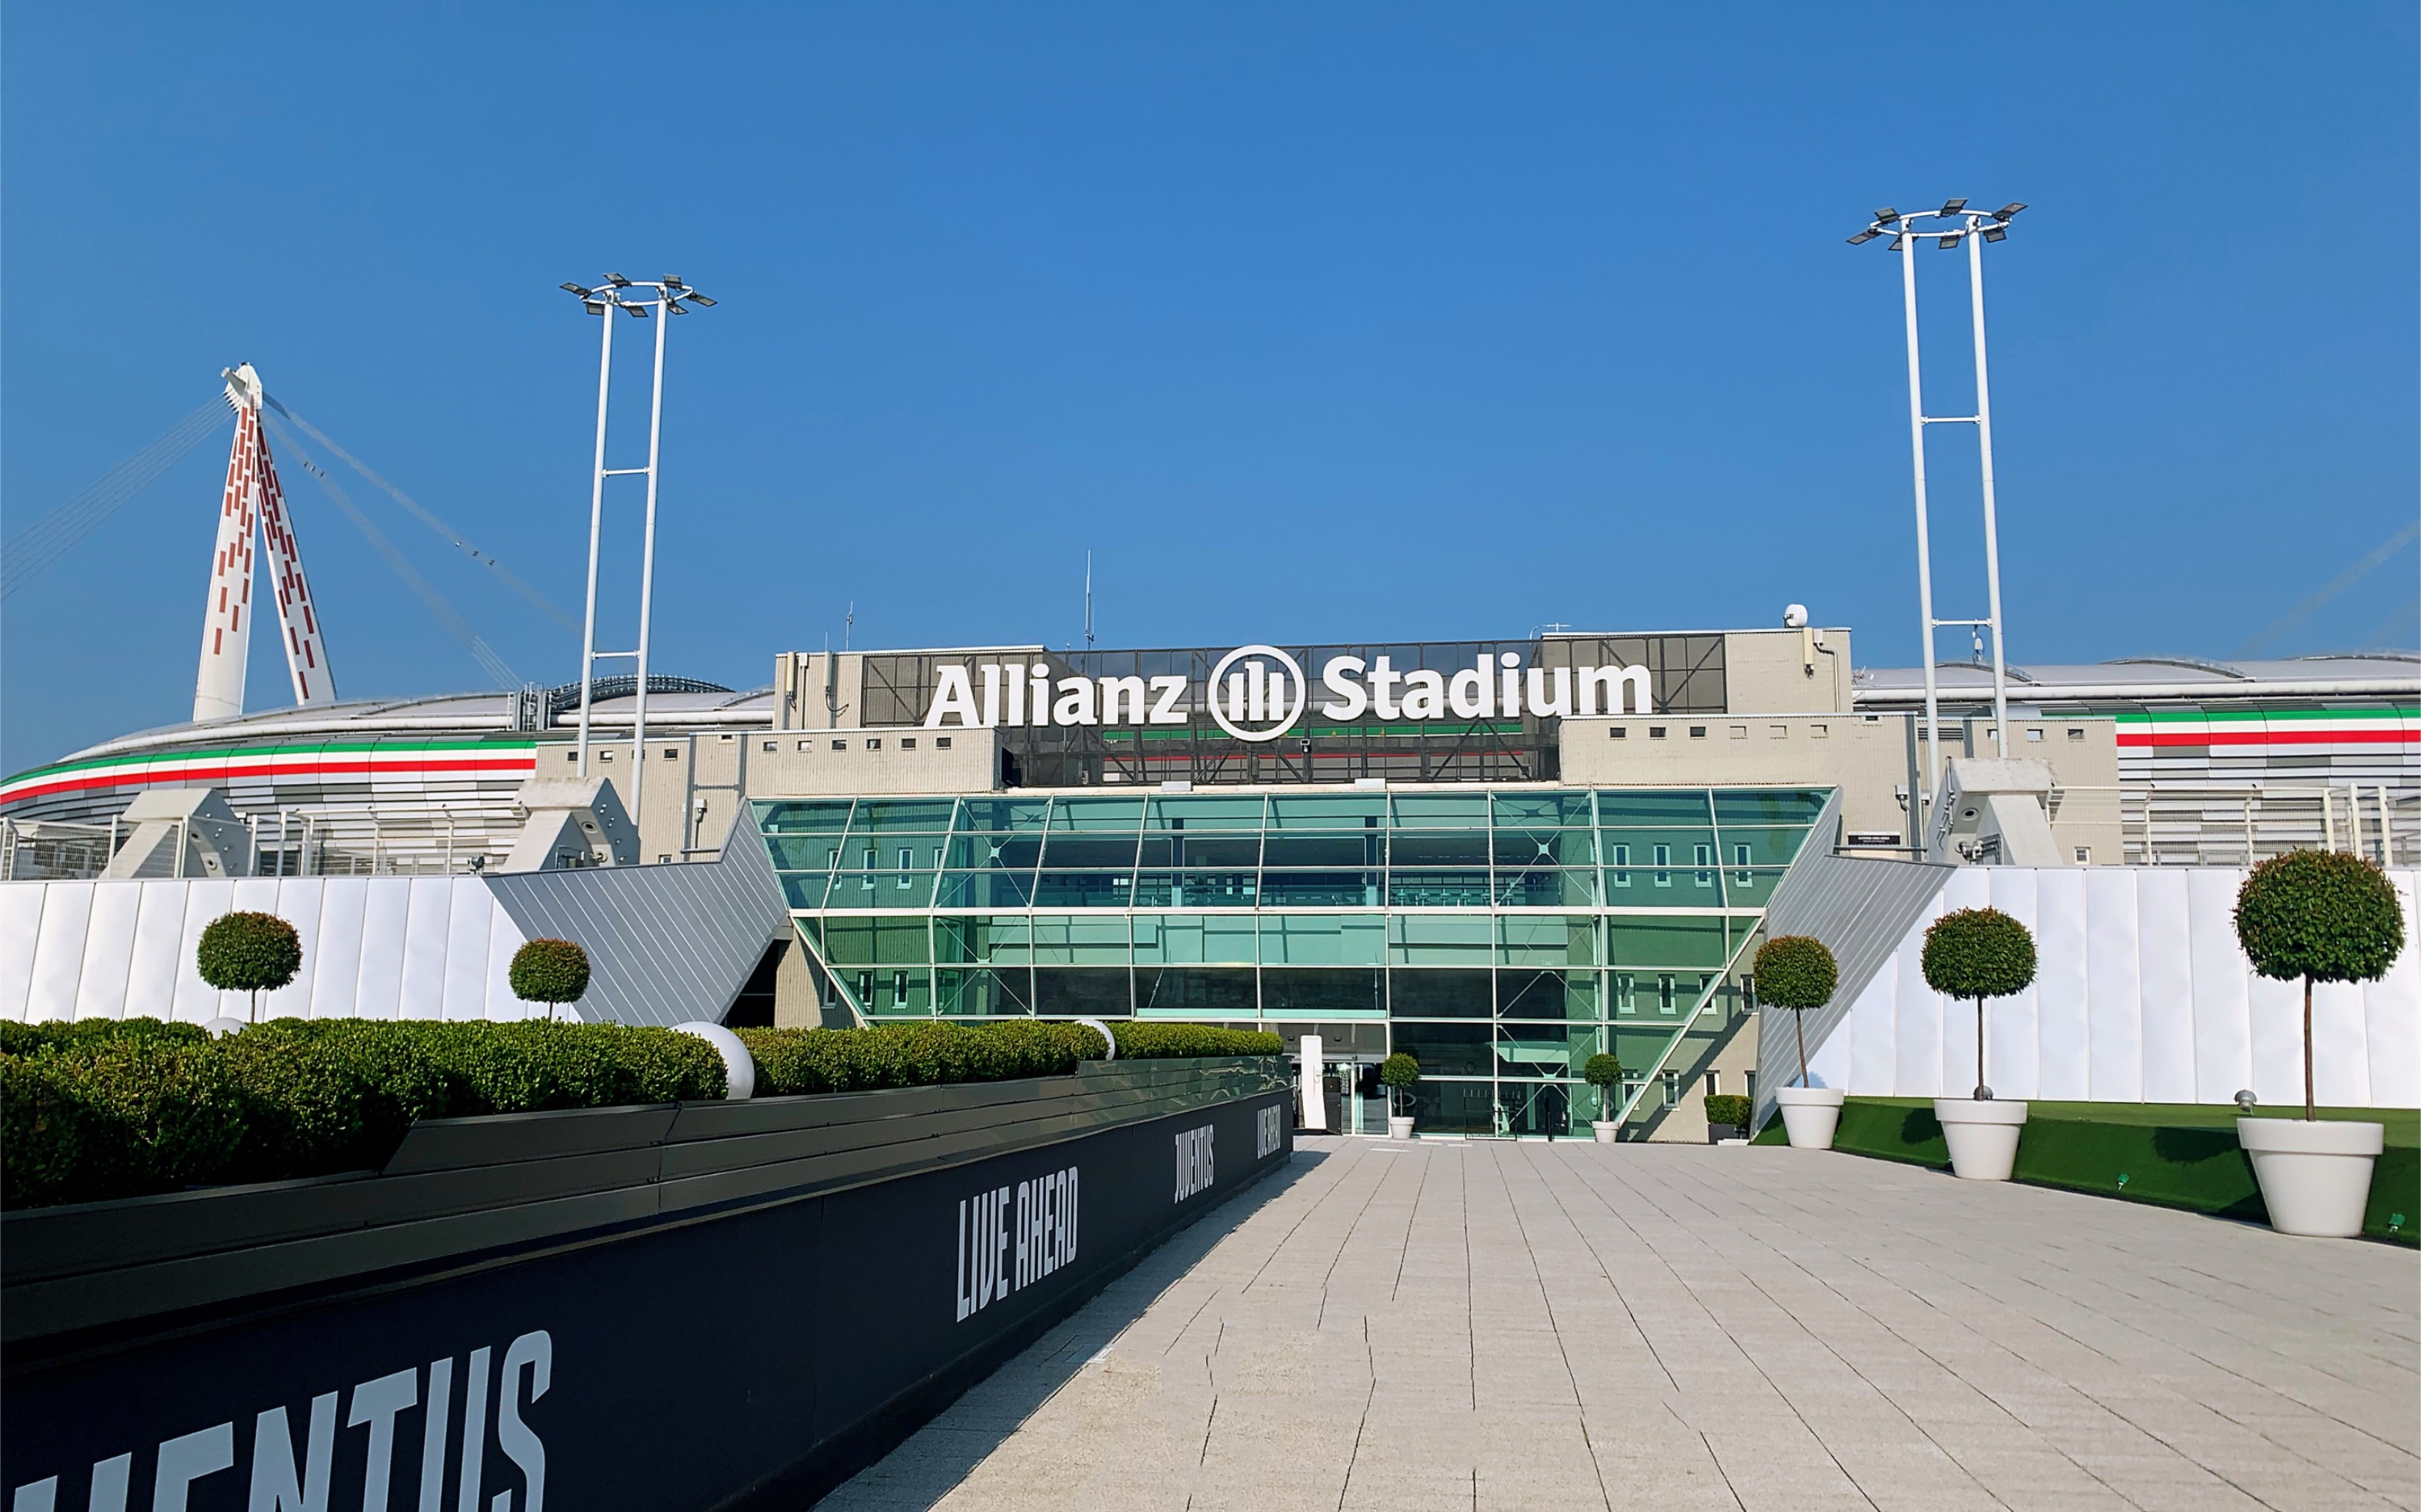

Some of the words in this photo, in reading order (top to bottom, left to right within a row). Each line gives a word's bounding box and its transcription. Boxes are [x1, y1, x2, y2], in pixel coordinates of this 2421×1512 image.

[924, 663, 1186, 728] Allianz
[1322, 653, 1652, 720] Stadium
[1174, 1123, 1214, 1205] JUVENTUS
[957, 1186, 1010, 1323] LIVE
[1015, 1166, 1078, 1292] AHEAD
[14, 1330, 552, 1512] TUS
